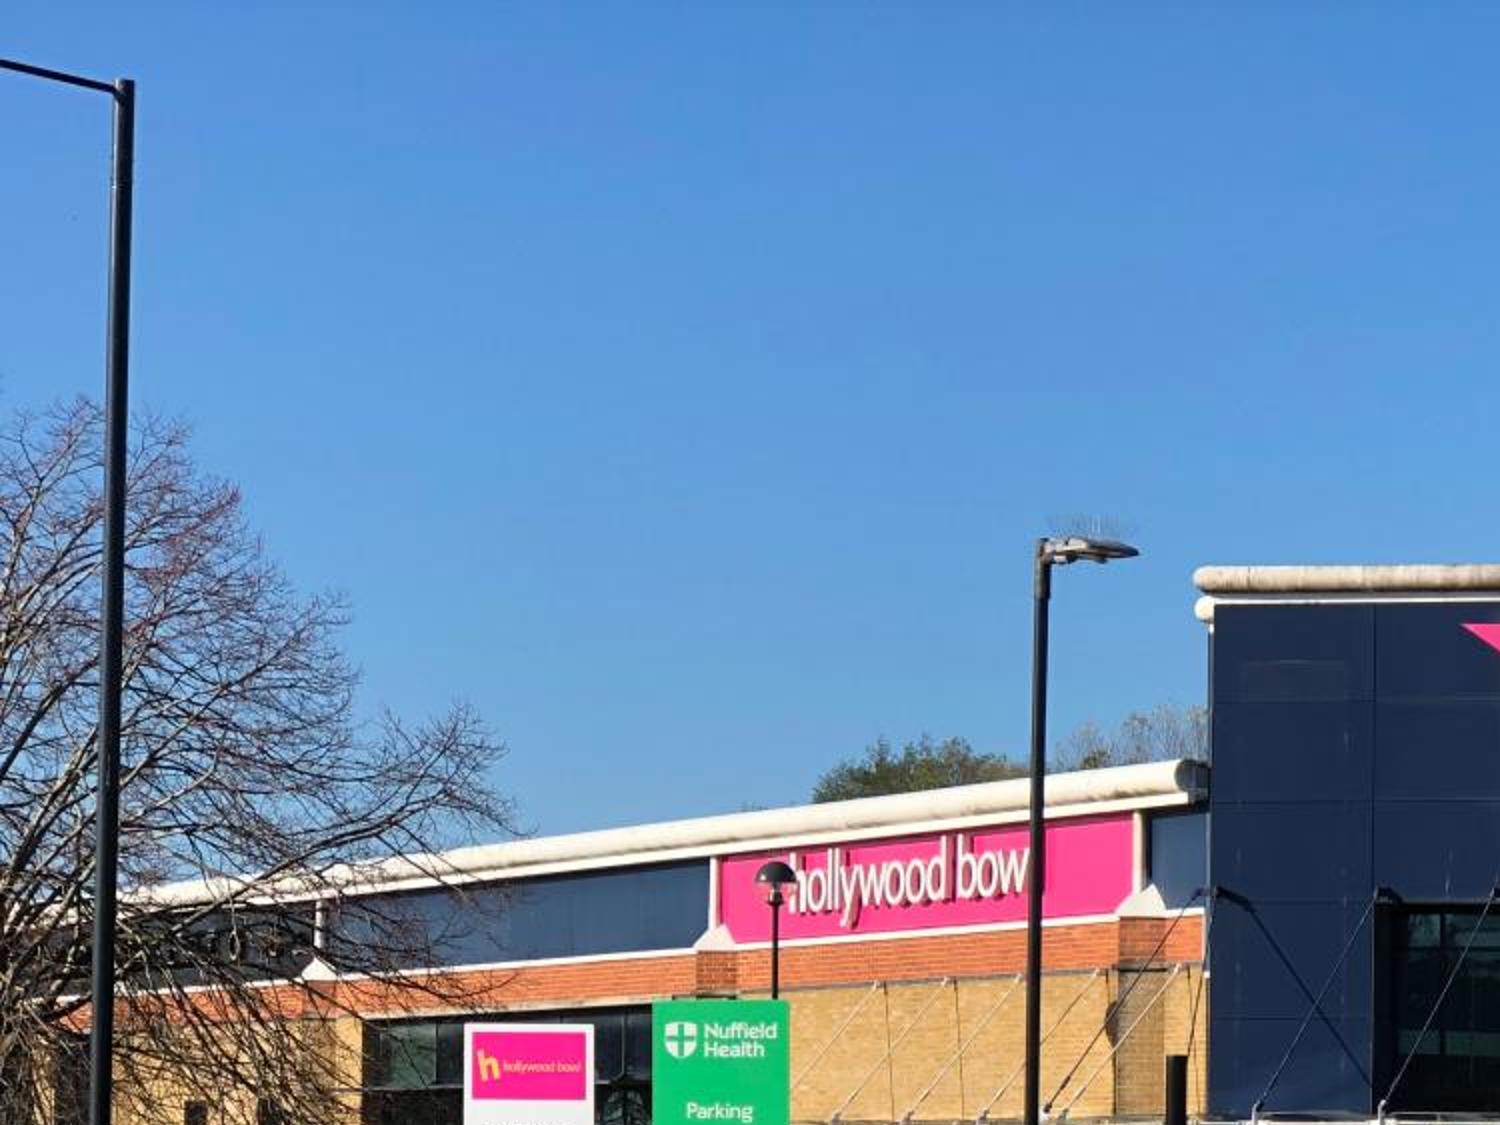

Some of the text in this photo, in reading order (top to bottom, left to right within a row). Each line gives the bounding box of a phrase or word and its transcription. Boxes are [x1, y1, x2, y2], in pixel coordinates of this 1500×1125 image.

[788, 833, 1031, 929] hollywood bow
[703, 1022, 778, 1039] Nuffield
[703, 1041, 765, 1058] Health
[686, 1102, 753, 1123] Parking
